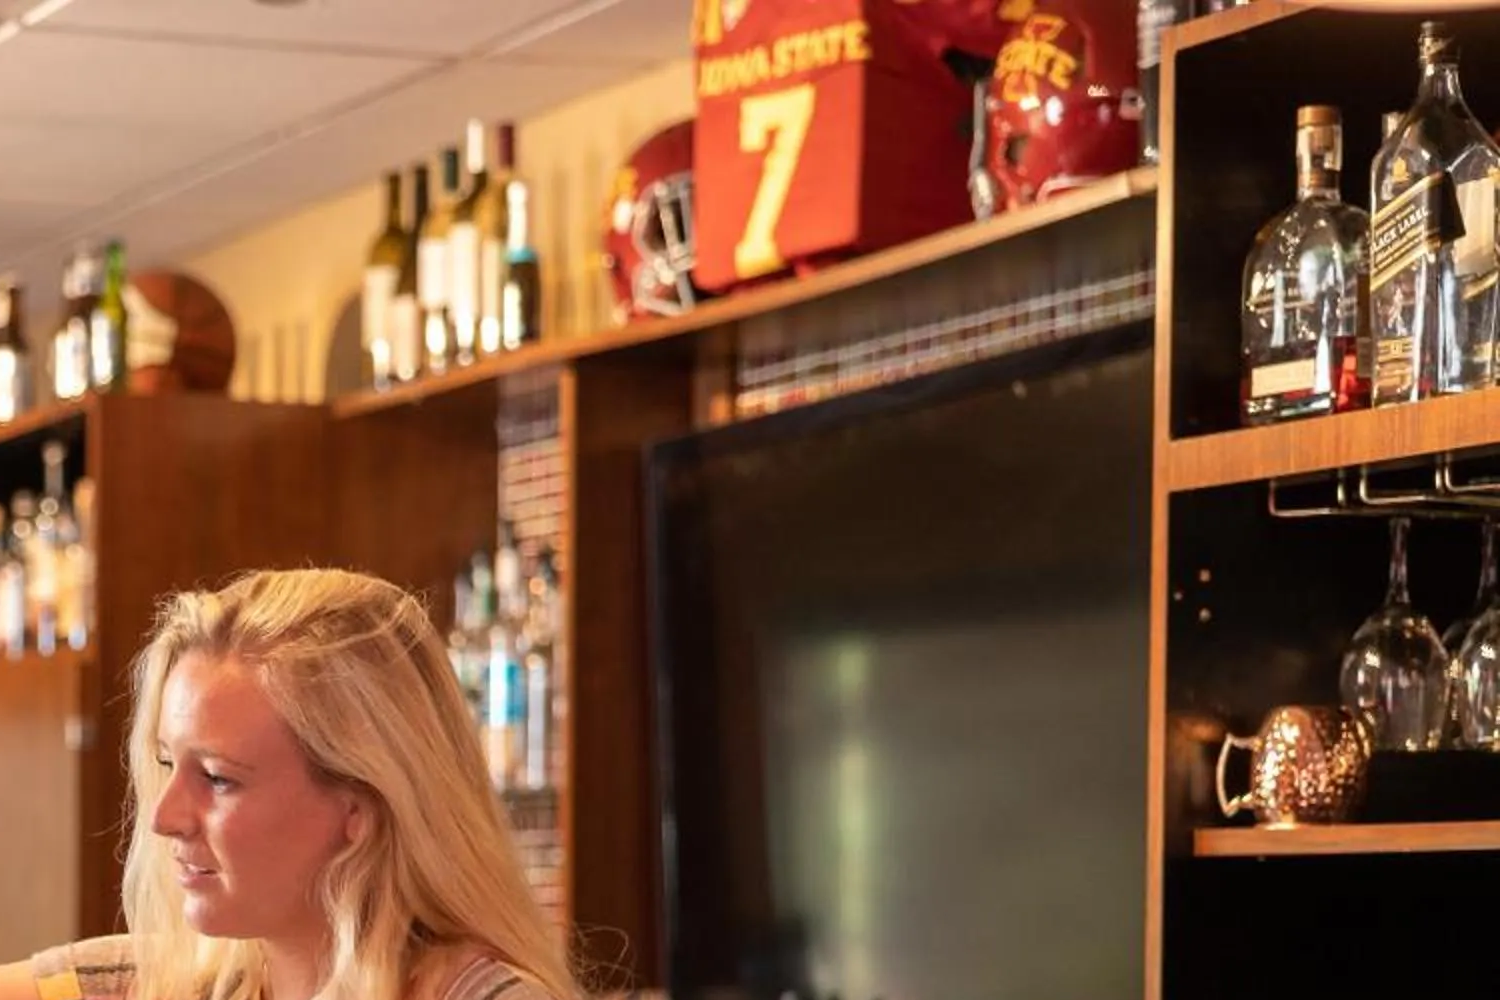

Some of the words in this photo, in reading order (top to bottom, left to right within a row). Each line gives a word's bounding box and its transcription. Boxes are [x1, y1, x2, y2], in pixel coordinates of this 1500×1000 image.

[771, 19, 872, 78] STATE
[735, 82, 816, 278] 7
[1370, 227, 1398, 252] LACK
[1397, 206, 1428, 234] LABEL
